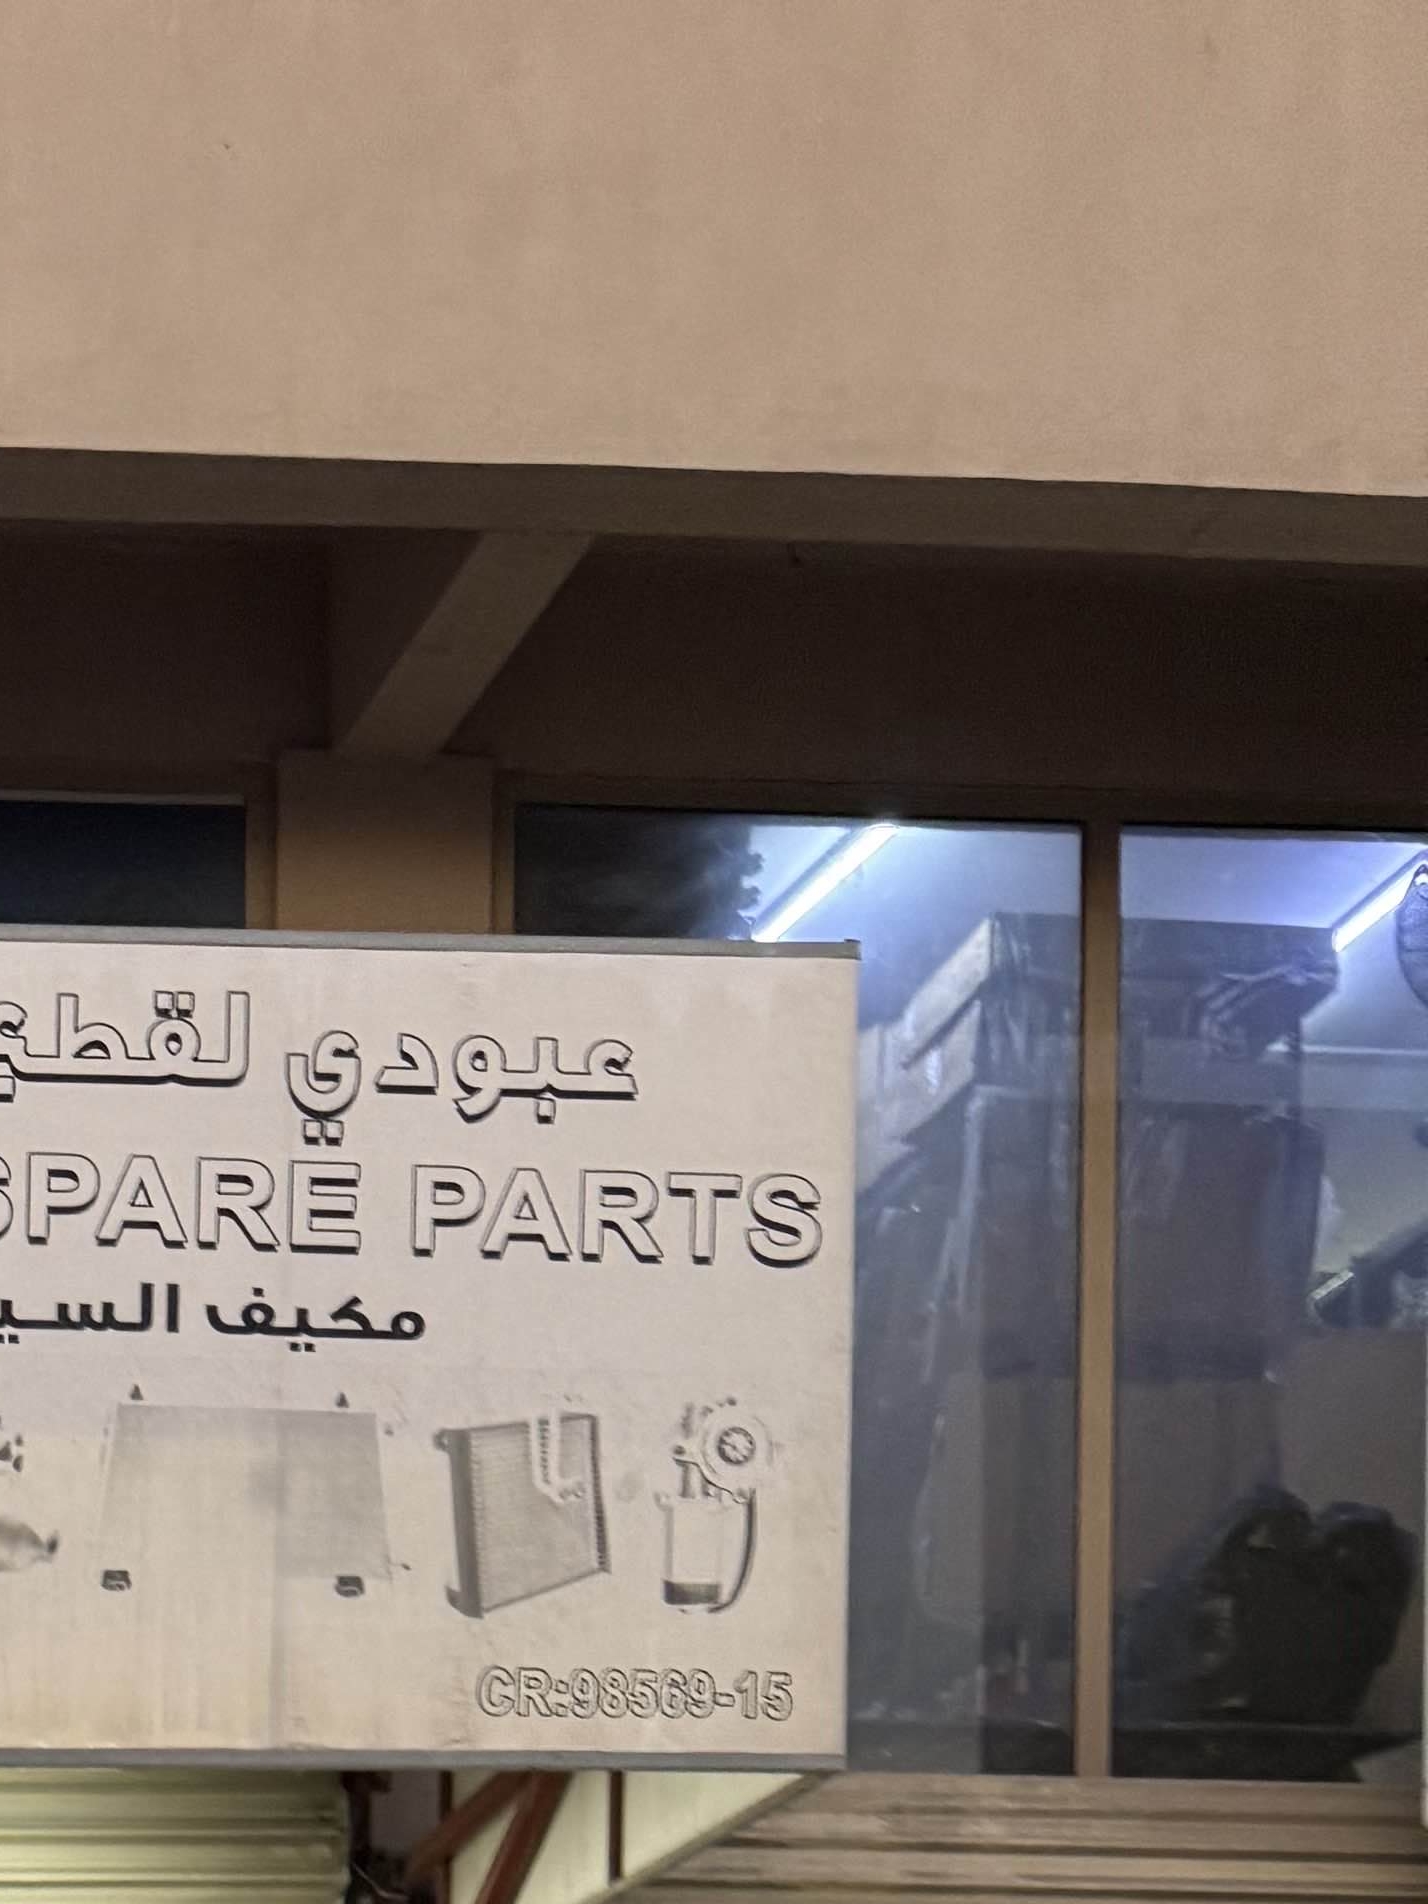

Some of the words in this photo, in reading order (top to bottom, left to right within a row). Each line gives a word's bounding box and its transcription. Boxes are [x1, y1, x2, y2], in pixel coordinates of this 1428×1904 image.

[284, 1030, 638, 1145] عبودي
[412, 1164, 822, 1268] PARTS
[206, 1287, 426, 1352] مكيف
